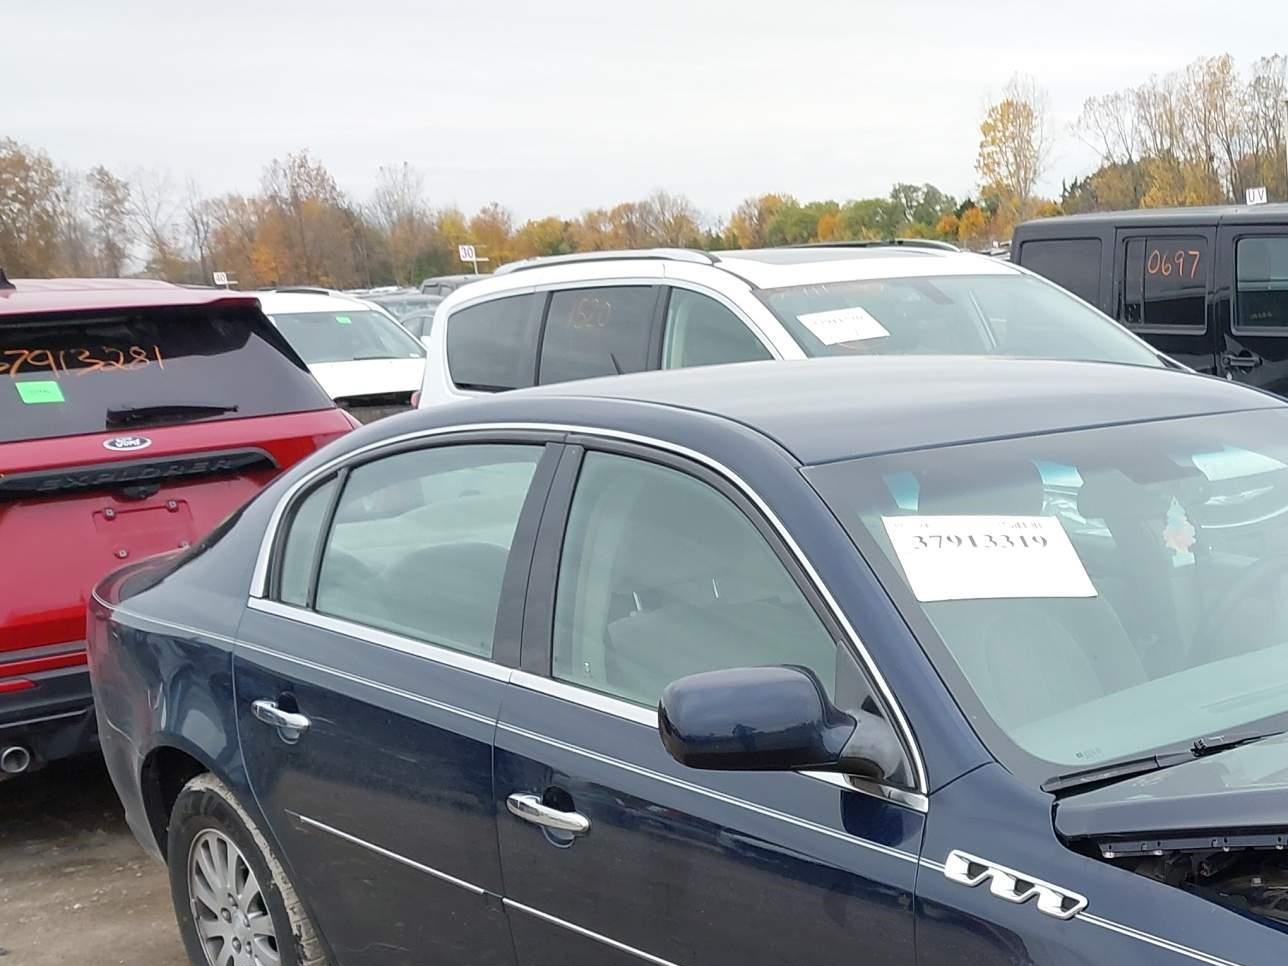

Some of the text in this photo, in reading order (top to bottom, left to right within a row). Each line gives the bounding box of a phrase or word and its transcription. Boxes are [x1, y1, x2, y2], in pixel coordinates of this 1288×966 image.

[462, 247, 474, 259] 30
[1147, 249, 1200, 279] 0697
[38, 459, 234, 491] EXPLORER
[911, 534, 1049, 550] 37913319
